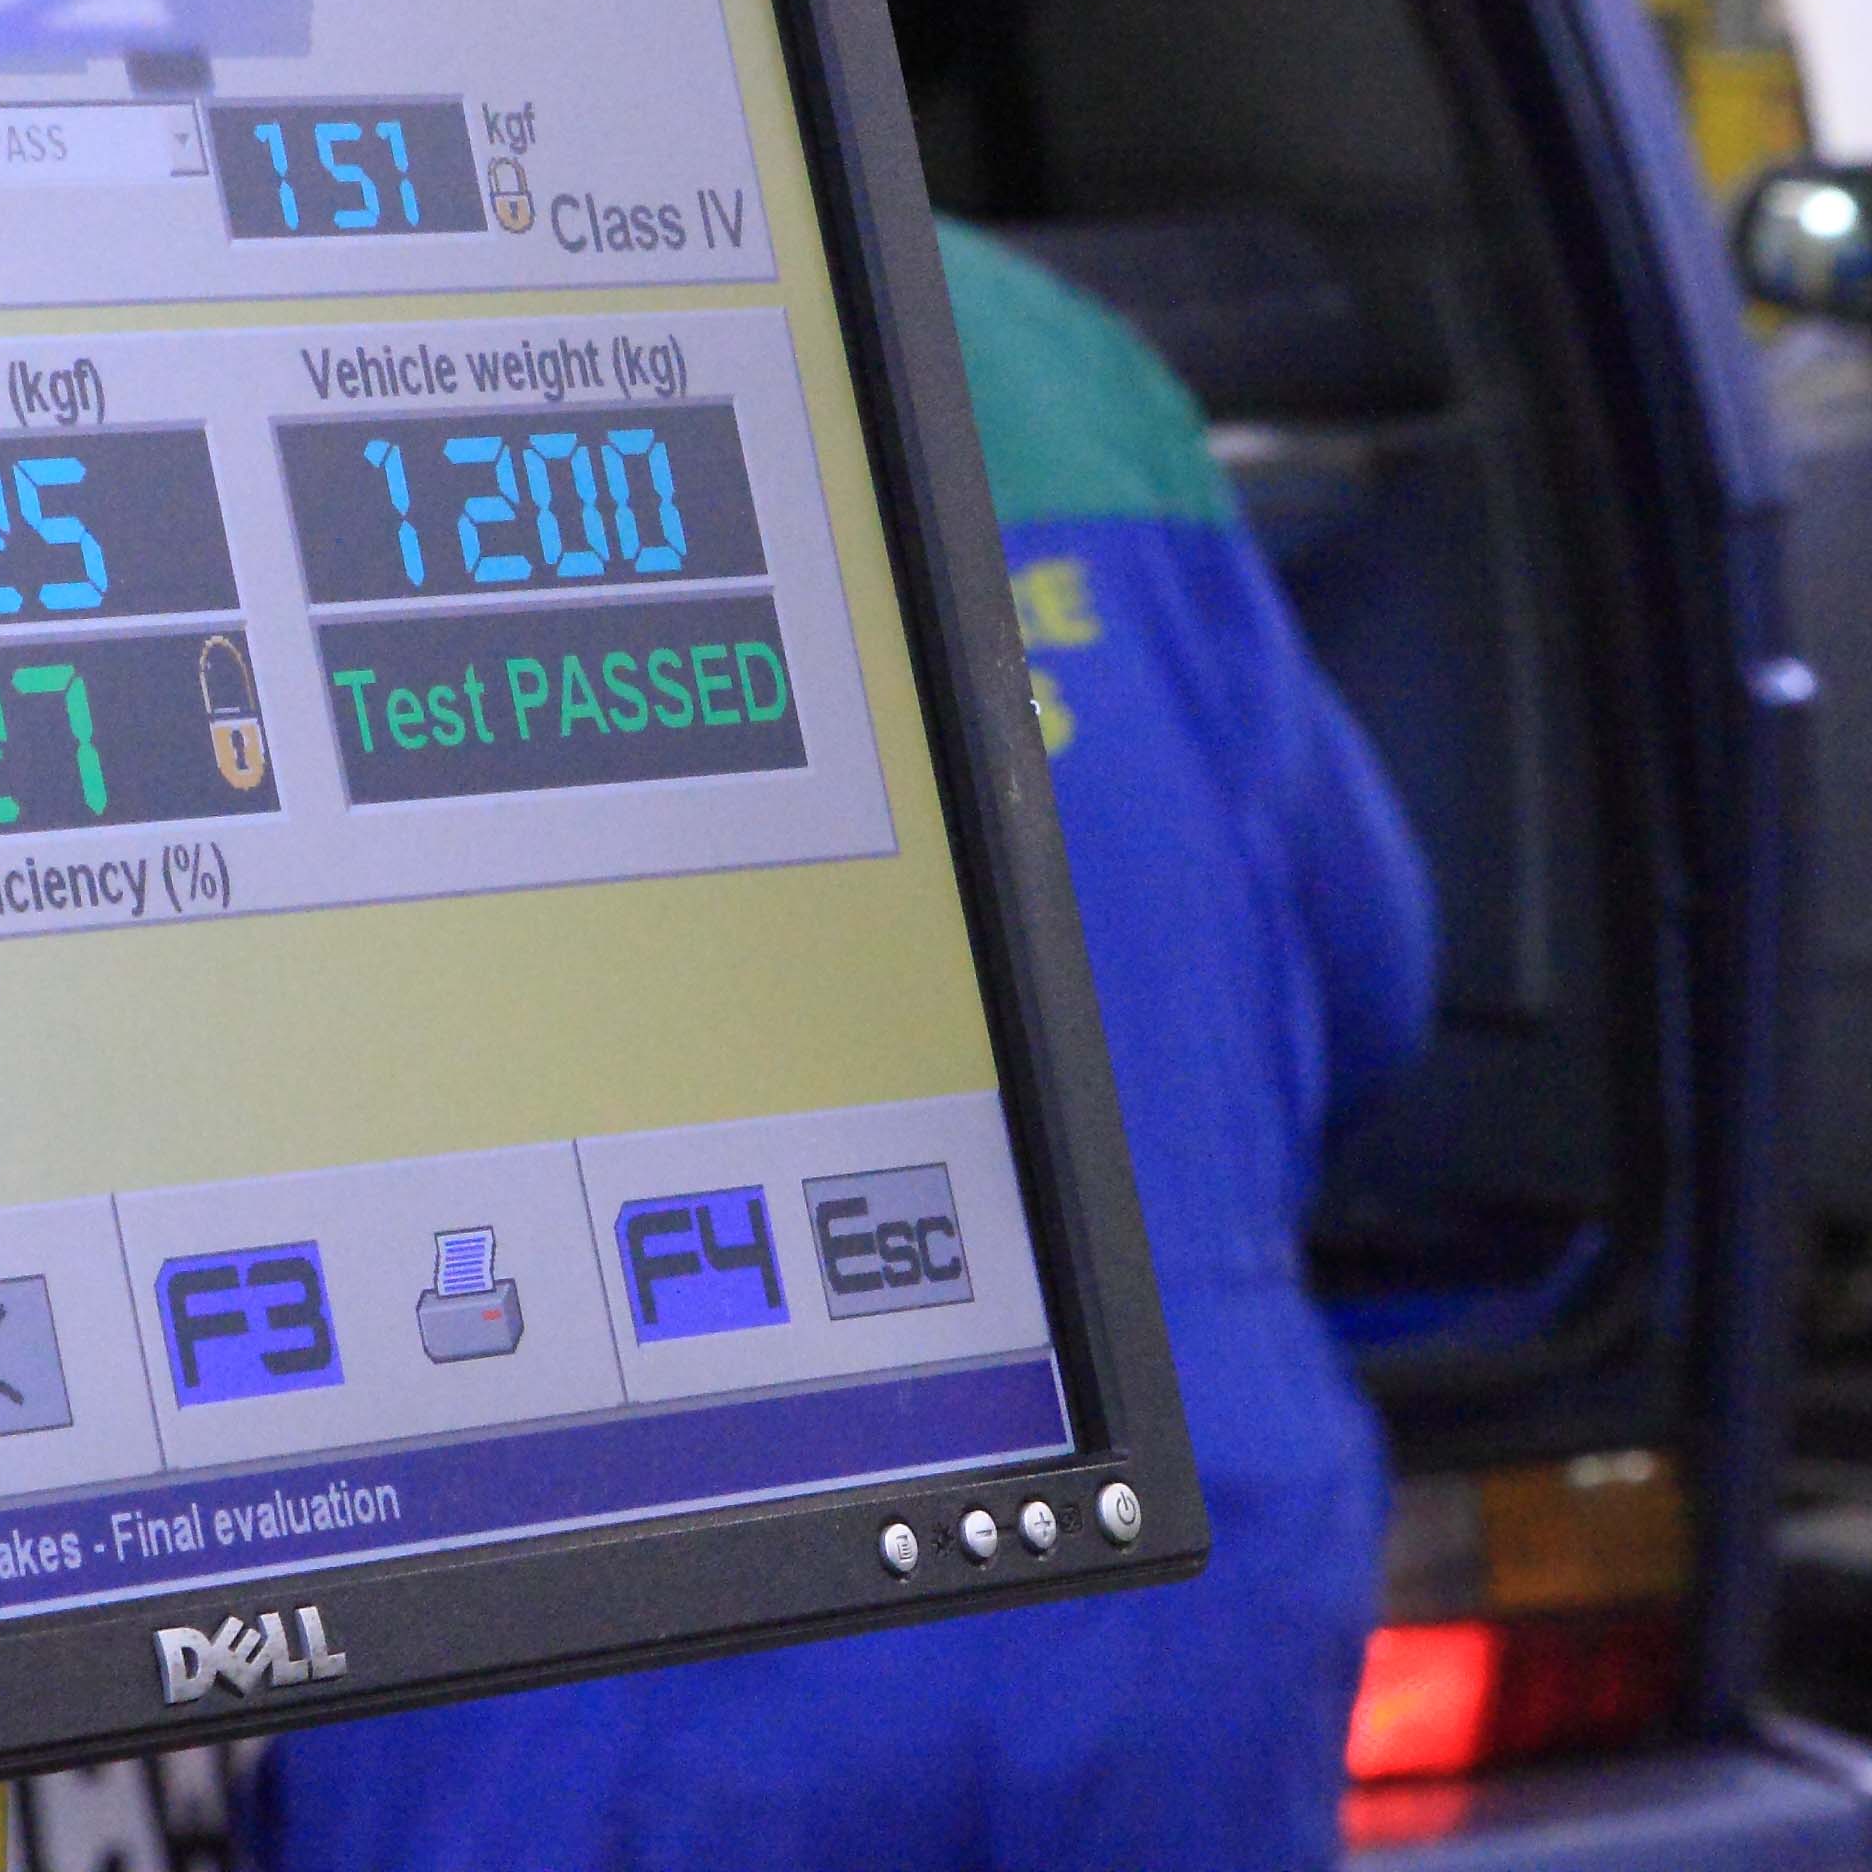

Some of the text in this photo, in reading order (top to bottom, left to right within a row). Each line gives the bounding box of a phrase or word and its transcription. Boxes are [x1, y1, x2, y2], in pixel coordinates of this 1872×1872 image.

[255, 102, 536, 231] 151 kgf
[551, 189, 745, 254] Class IV
[7, 357, 108, 431] (kgf)
[302, 332, 688, 405] Vehicle weight (kg)
[364, 428, 688, 587] 1200
[334, 641, 789, 757] Test PASSED
[161, 842, 233, 910] (%)
[623, 1198, 783, 1326] F4
[815, 1196, 964, 1295] Esc
[164, 1253, 333, 1389] F3
[109, 1501, 206, 1559] Final
[212, 1479, 402, 1550] evaluation
[154, 1604, 347, 1705] DELL
